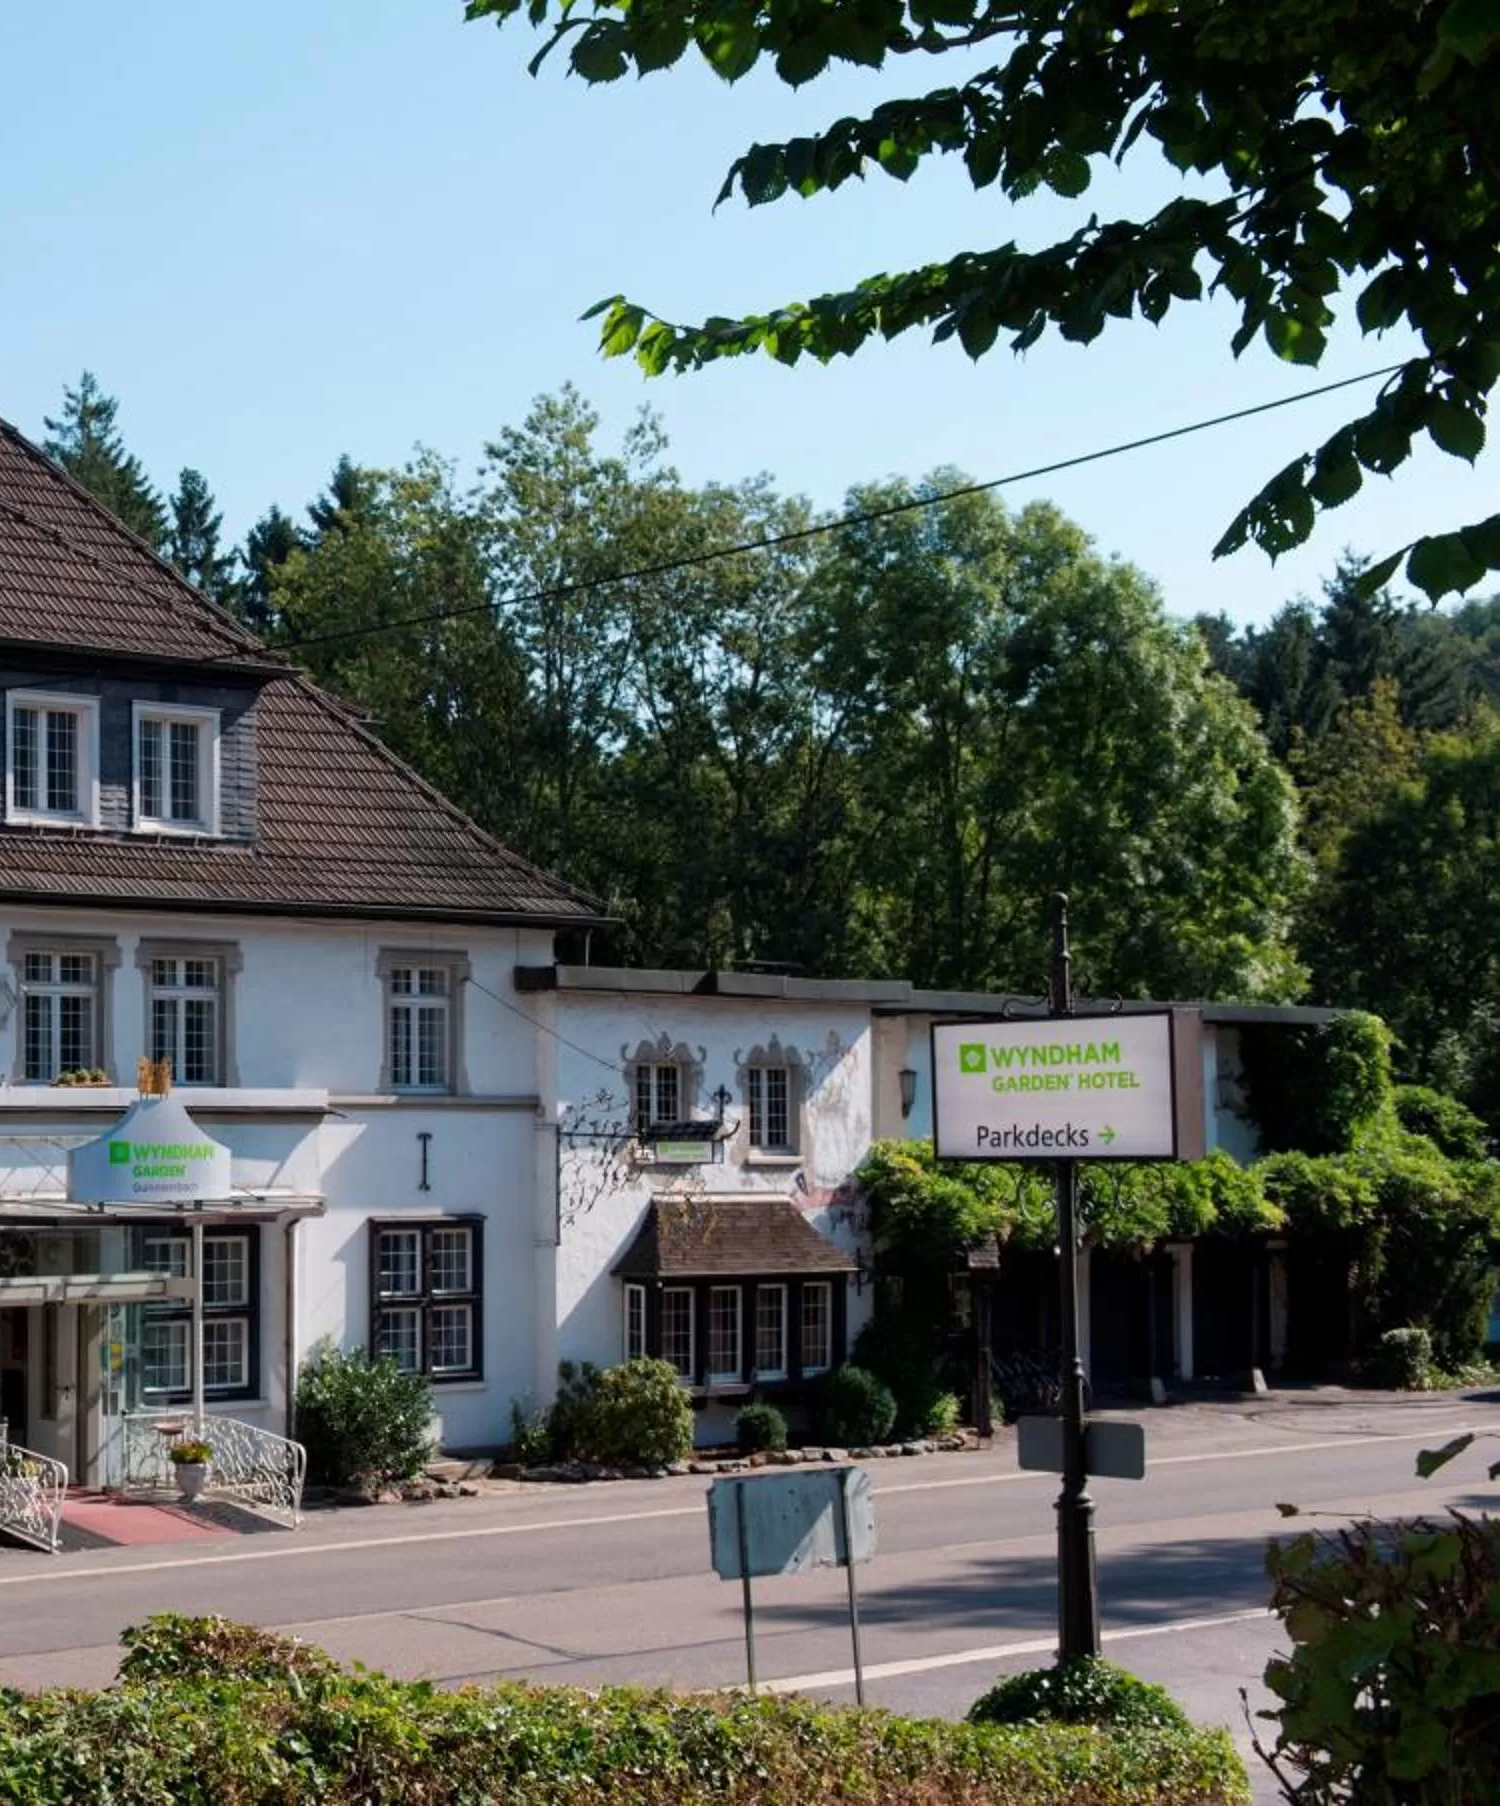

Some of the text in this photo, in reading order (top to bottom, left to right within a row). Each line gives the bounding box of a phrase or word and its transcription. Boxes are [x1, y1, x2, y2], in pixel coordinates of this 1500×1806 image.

[990, 1041, 1121, 1068] WYNDHAM
[1077, 1071, 1141, 1089] HOTEL
[976, 1122, 1090, 1148] Parkdecks
[133, 1143, 213, 1160] WYNDHAM
